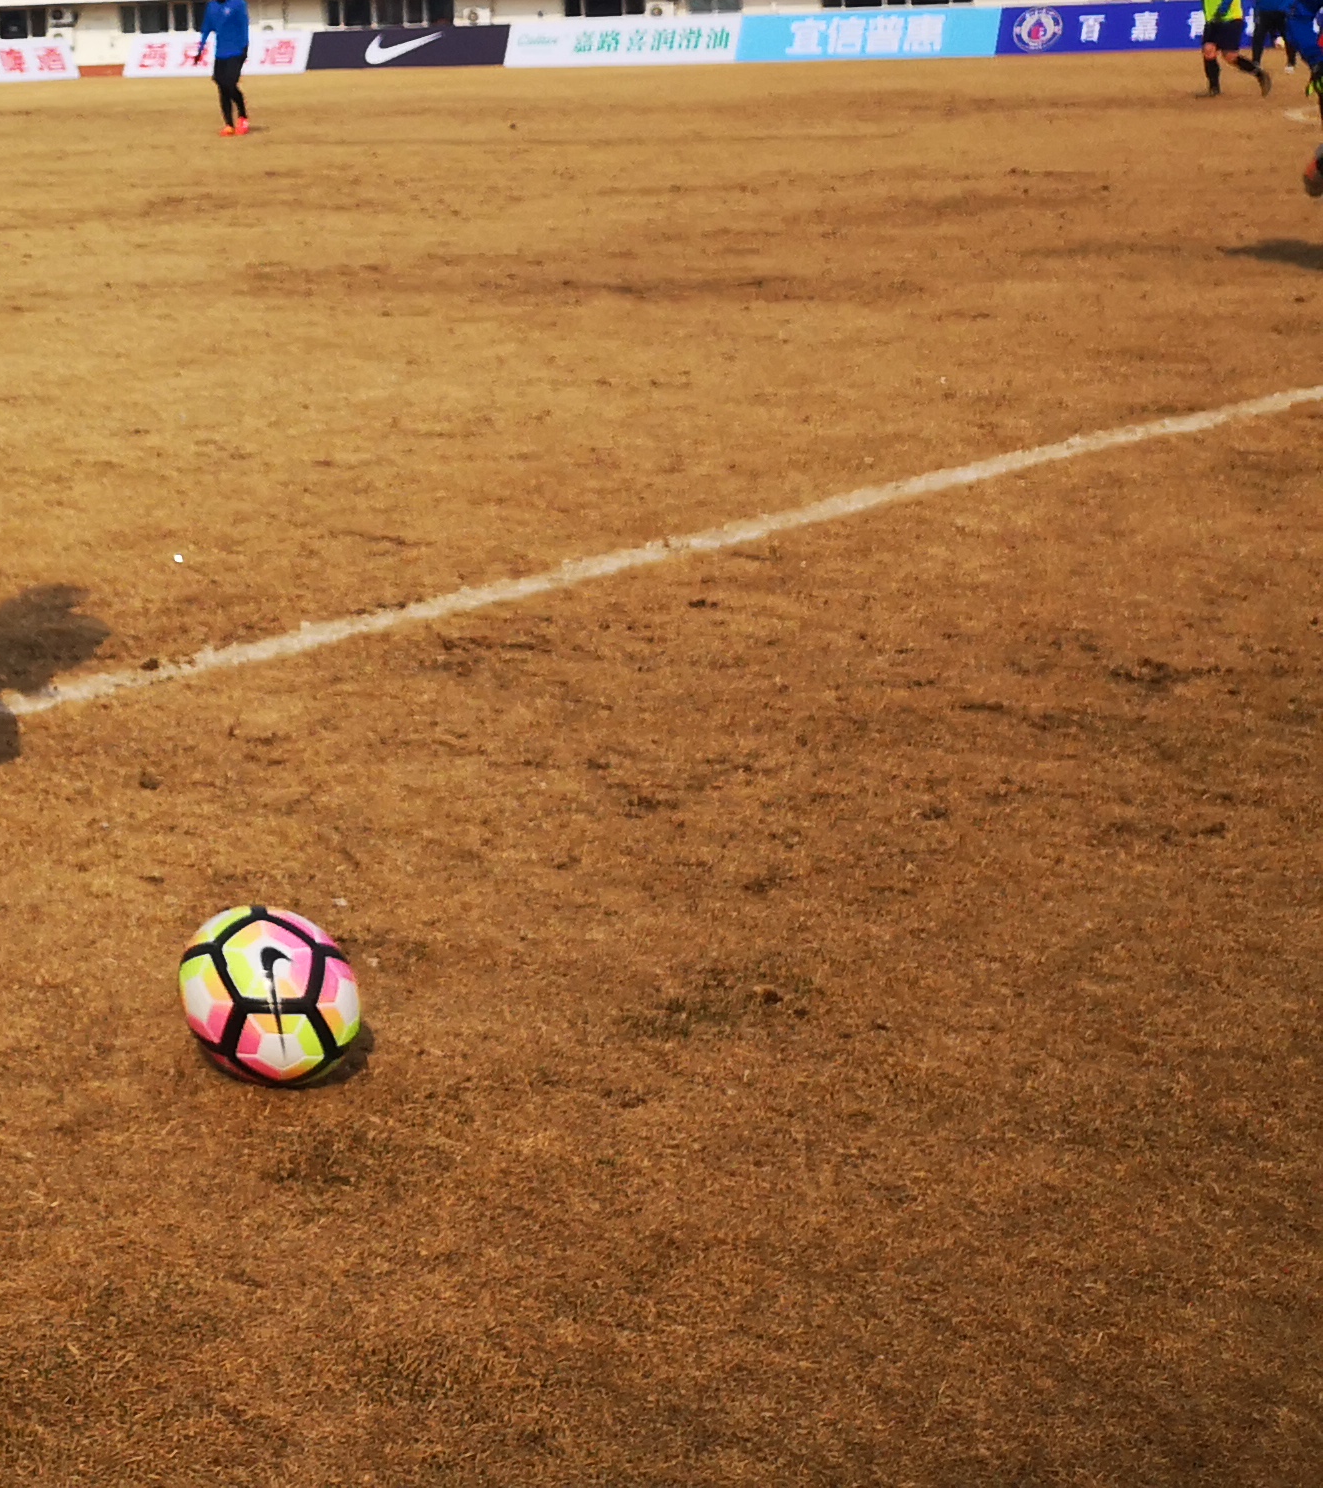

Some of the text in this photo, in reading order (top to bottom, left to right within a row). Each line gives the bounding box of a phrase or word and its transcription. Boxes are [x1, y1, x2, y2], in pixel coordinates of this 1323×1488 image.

[785, 15, 946, 55] 宜信普惠
[139, 38, 298, 68] 燕京酒
